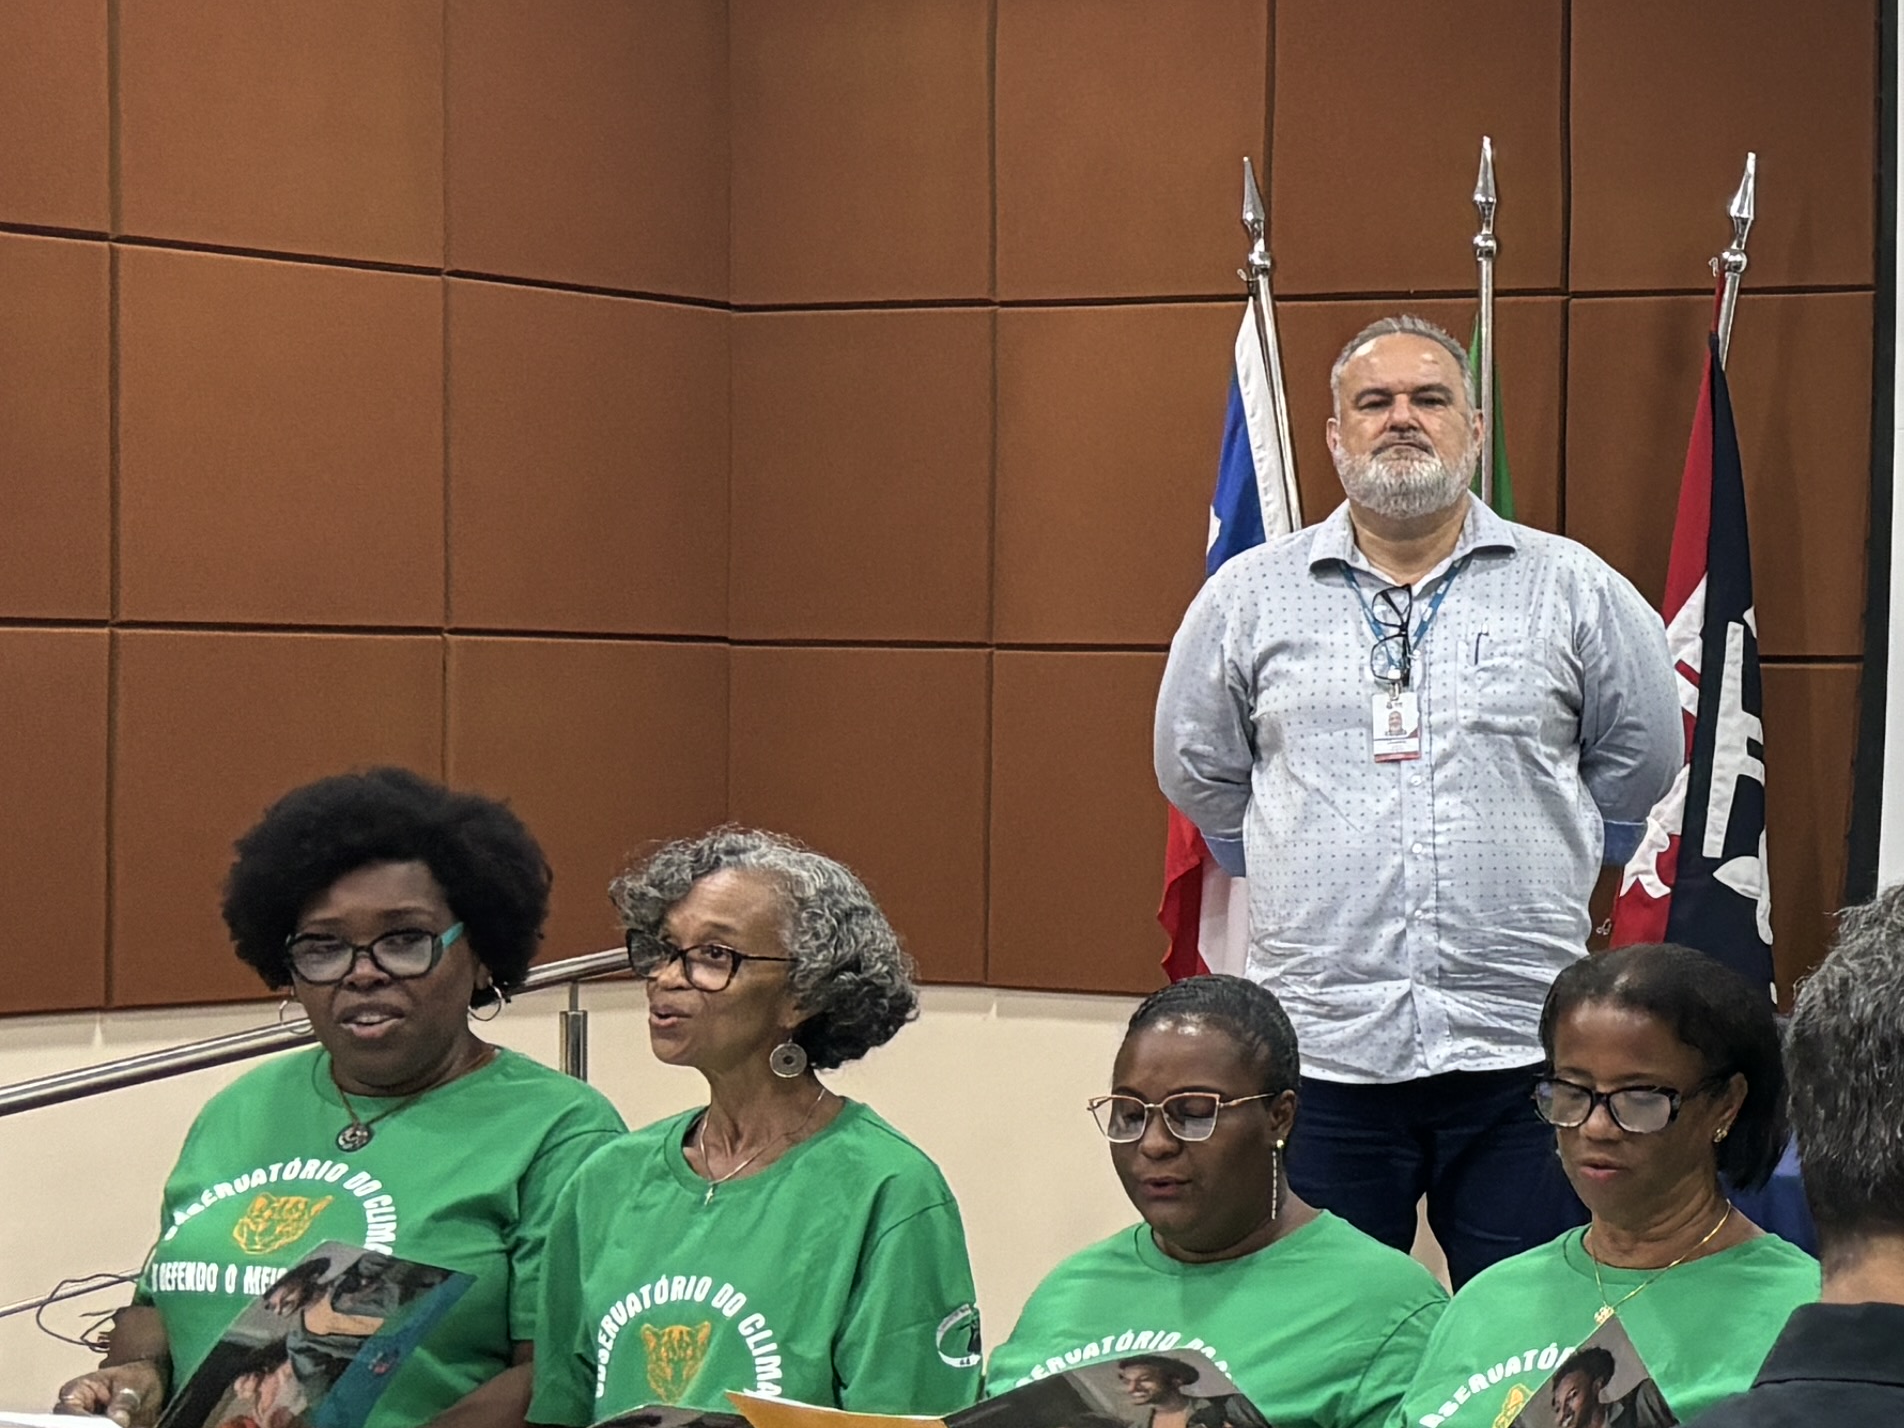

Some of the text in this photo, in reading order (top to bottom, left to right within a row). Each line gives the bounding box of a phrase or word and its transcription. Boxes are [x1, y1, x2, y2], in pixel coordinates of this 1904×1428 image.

[343, 1171, 382, 1197] DO
[225, 1264, 237, 1293] O
[711, 1283, 747, 1317] DO
[737, 1312, 783, 1397] CLIMA
